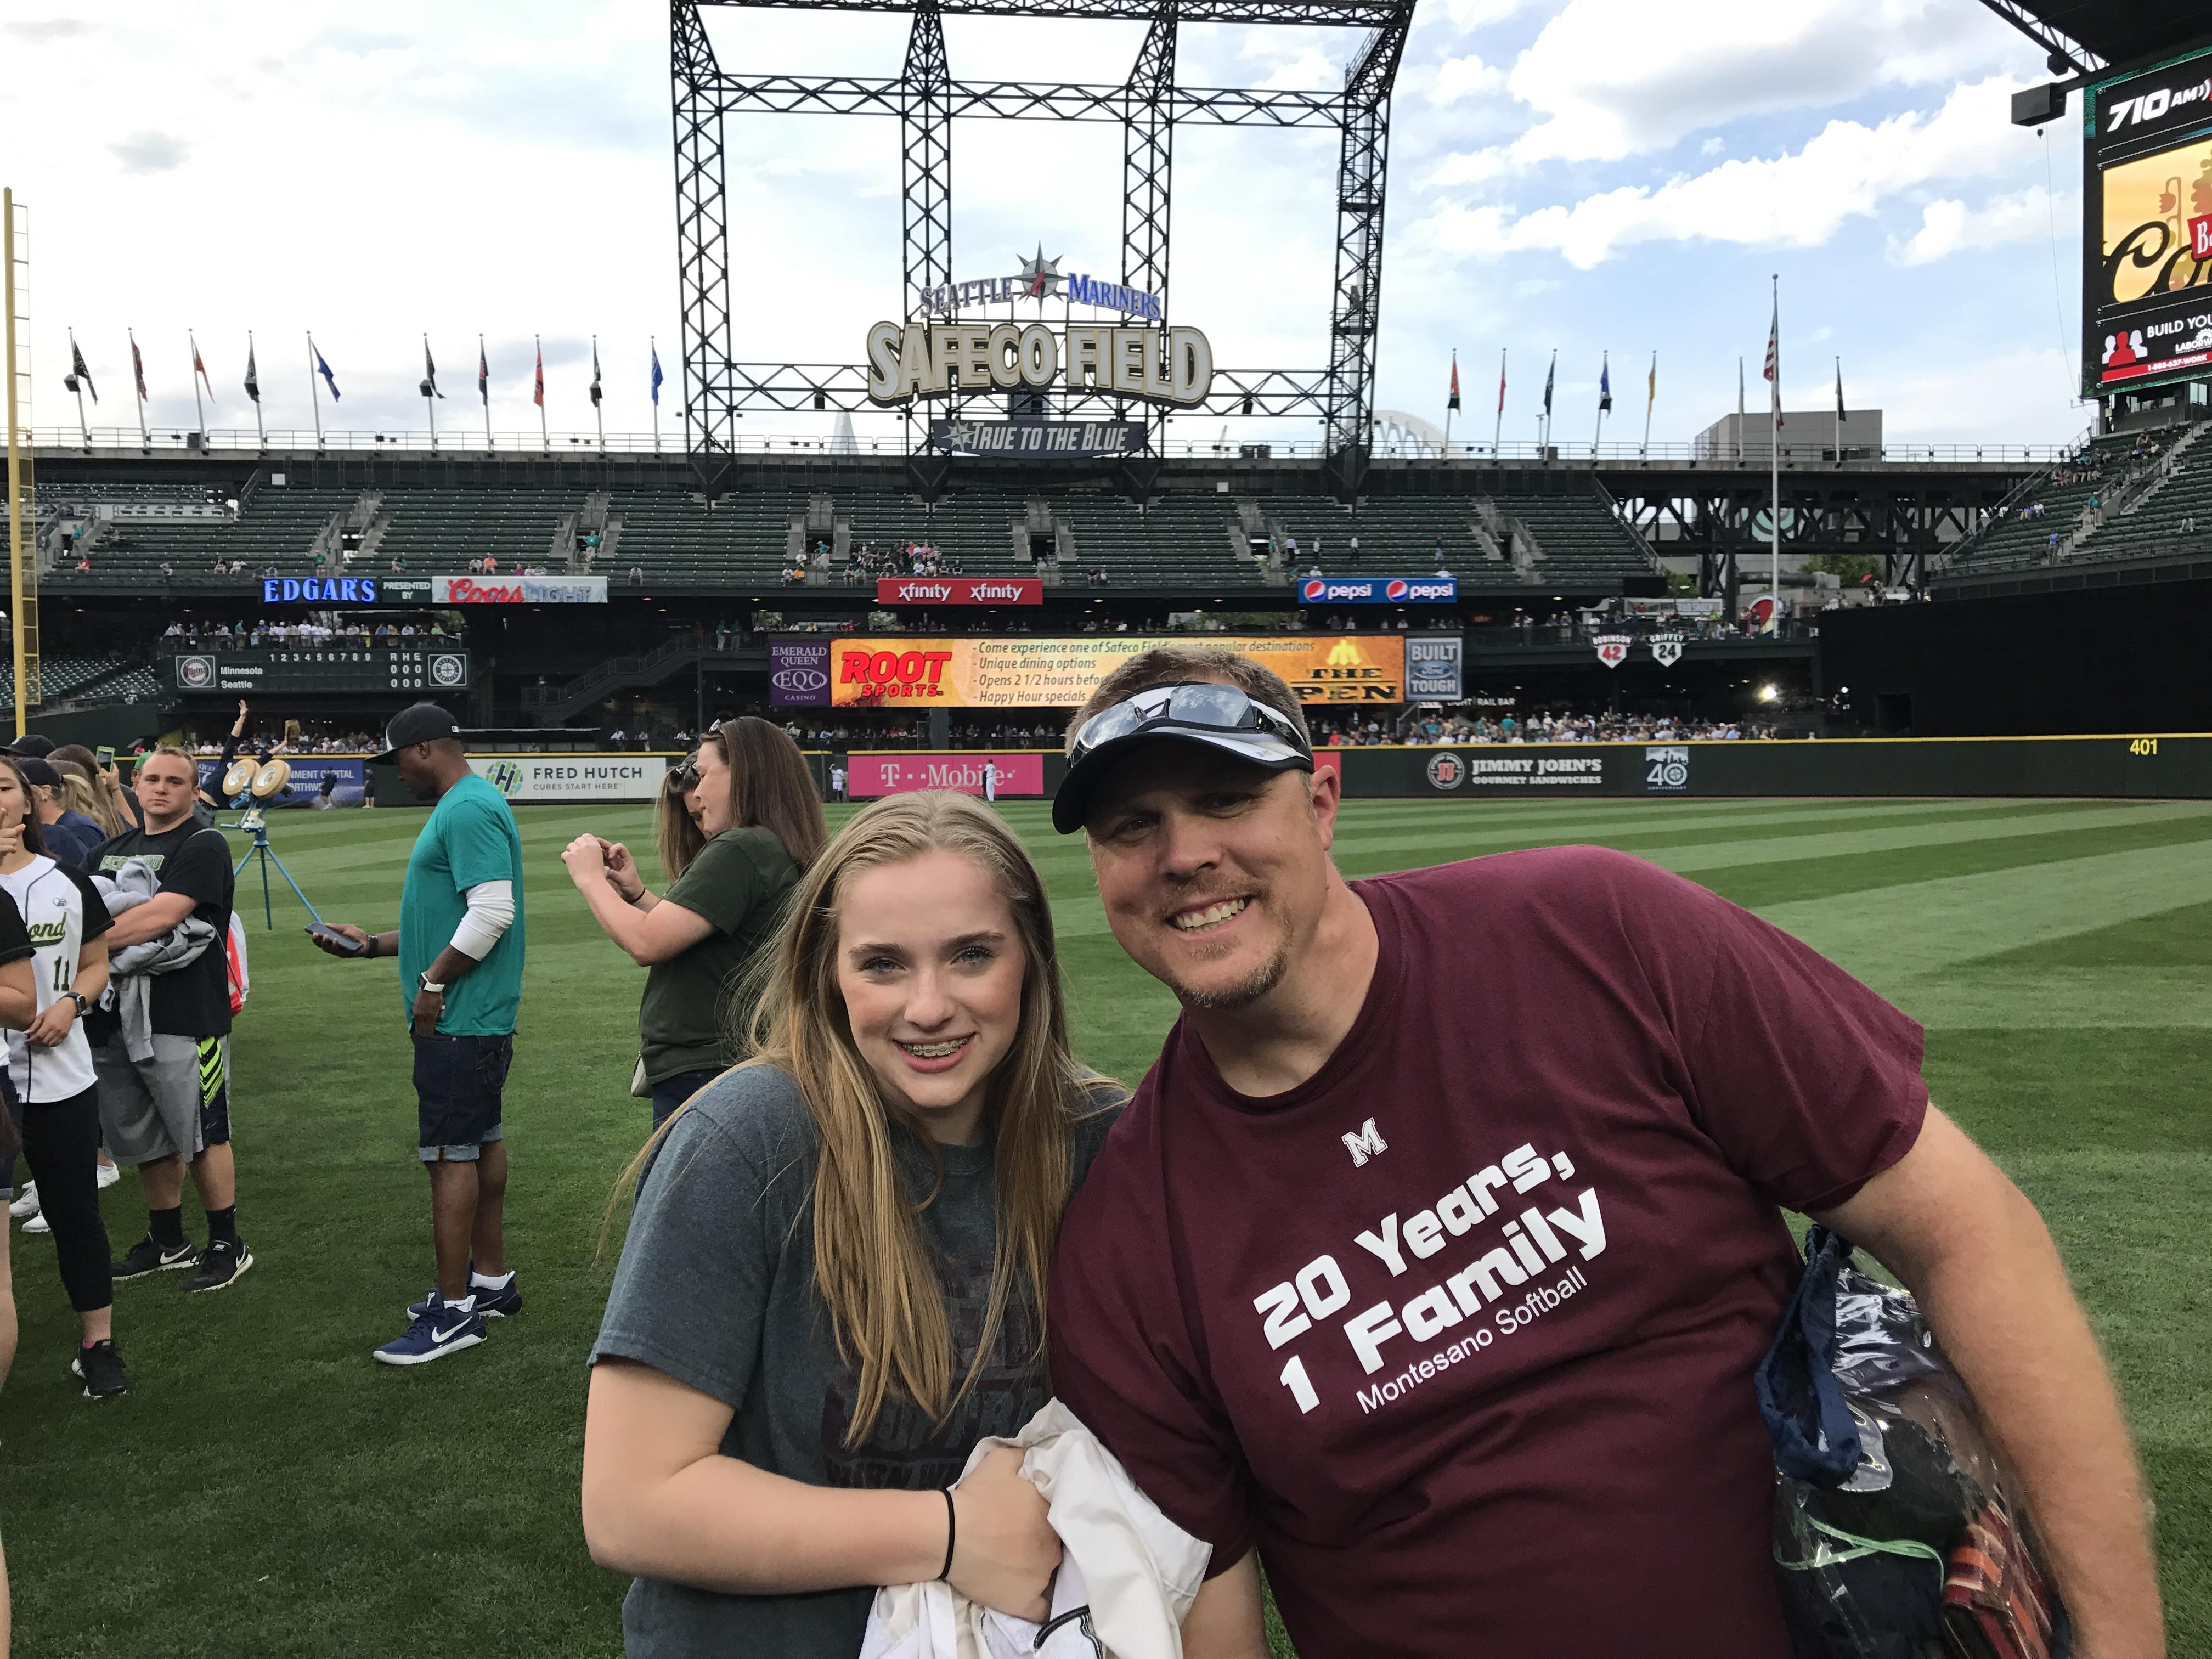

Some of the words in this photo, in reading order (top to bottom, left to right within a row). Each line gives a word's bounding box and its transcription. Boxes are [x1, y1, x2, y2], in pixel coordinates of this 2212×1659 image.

[2107, 88, 2171, 132] 710
[2171, 86, 2198, 107] AM
[919, 277, 1013, 319] SEATTLE
[1067, 272, 1162, 321] MARINERS
[2147, 320, 2184, 338] BUILD
[867, 321, 1058, 407] SAFECO
[1066, 325, 1212, 408] FIELD
[2147, 354, 2208, 371] 1-888-637-WORK
[971, 421, 1015, 450] TRUE
[1020, 427, 1042, 450] TO
[1046, 427, 1079, 450] THE
[1084, 423, 1128, 451] BLUE
[383, 581, 431, 590] PRESENTED
[448, 578, 524, 603] Coors
[524, 585, 592, 603] LIGHT
[898, 583, 951, 601] xfinity
[970, 583, 1023, 601] xfinity
[1328, 583, 1372, 599] pepsi
[1409, 583, 1454, 599] pepsi
[402, 591, 413, 600] BY
[772, 647, 827, 657] EMERALD
[978, 642, 1009, 653] Come
[1011, 642, 1067, 656] experience
[1070, 645, 1089, 653] one
[1091, 641, 1103, 653] of
[1104, 641, 1139, 653] Safeco
[1249, 641, 1315, 652] destinations
[1412, 645, 1457, 661] BUILT
[1602, 646, 1621, 660] 42
[1658, 645, 1677, 658] 24
[390, 653, 397, 661] R
[402, 653, 409, 661] H
[781, 656, 818, 667] QUEEN
[979, 657, 1017, 673] Unique
[1019, 657, 1053, 672] dining
[1057, 658, 1096, 672] options
[220, 666, 263, 675] Minnesota
[391, 665, 397, 674] 0
[403, 665, 409, 674] 0
[415, 665, 421, 674] 0
[840, 651, 952, 683] ROOT
[1306, 668, 1383, 679] THE
[221, 680, 253, 689] Seattle
[391, 679, 397, 687] 0
[403, 679, 409, 687] 0
[414, 679, 421, 687] 0
[779, 672, 823, 691] EQC
[979, 675, 1012, 689] Opens
[1014, 675, 1021, 685] 2
[1024, 674, 1041, 685] 1/2
[1043, 674, 1074, 685] hours
[1076, 674, 1105, 685] befo
[1410, 679, 1456, 692] TOUGH
[861, 684, 939, 697] SPORTS
[979, 690, 1014, 705] Happy
[1017, 691, 1042, 702] Hour
[1477, 697, 1497, 706] RAIL
[1498, 697, 1516, 706] BAR
[2130, 738, 2158, 755] 401
[320, 770, 355, 779] CITAL
[533, 767, 578, 779] FRED
[585, 766, 642, 779] HUTCH
[926, 763, 1005, 787] Mobie
[1472, 759, 1533, 775] JIMMY
[1537, 759, 1602, 775] JOHN'S
[1646, 763, 1688, 786] 40
[1472, 776, 1527, 785] GOURMET
[1529, 776, 1602, 785] SANDWICHES
[53, 956, 70, 991] 11
[1341, 1116, 1388, 1168] M
[1253, 1254, 1351, 1351] 20
[1353, 1143, 1576, 1277] Years,
[1279, 1355, 1320, 1414] 1
[1343, 1187, 1607, 1375] Family
[1356, 1325, 1493, 1414] Montesano
[1495, 1265, 1588, 1335] Softball
